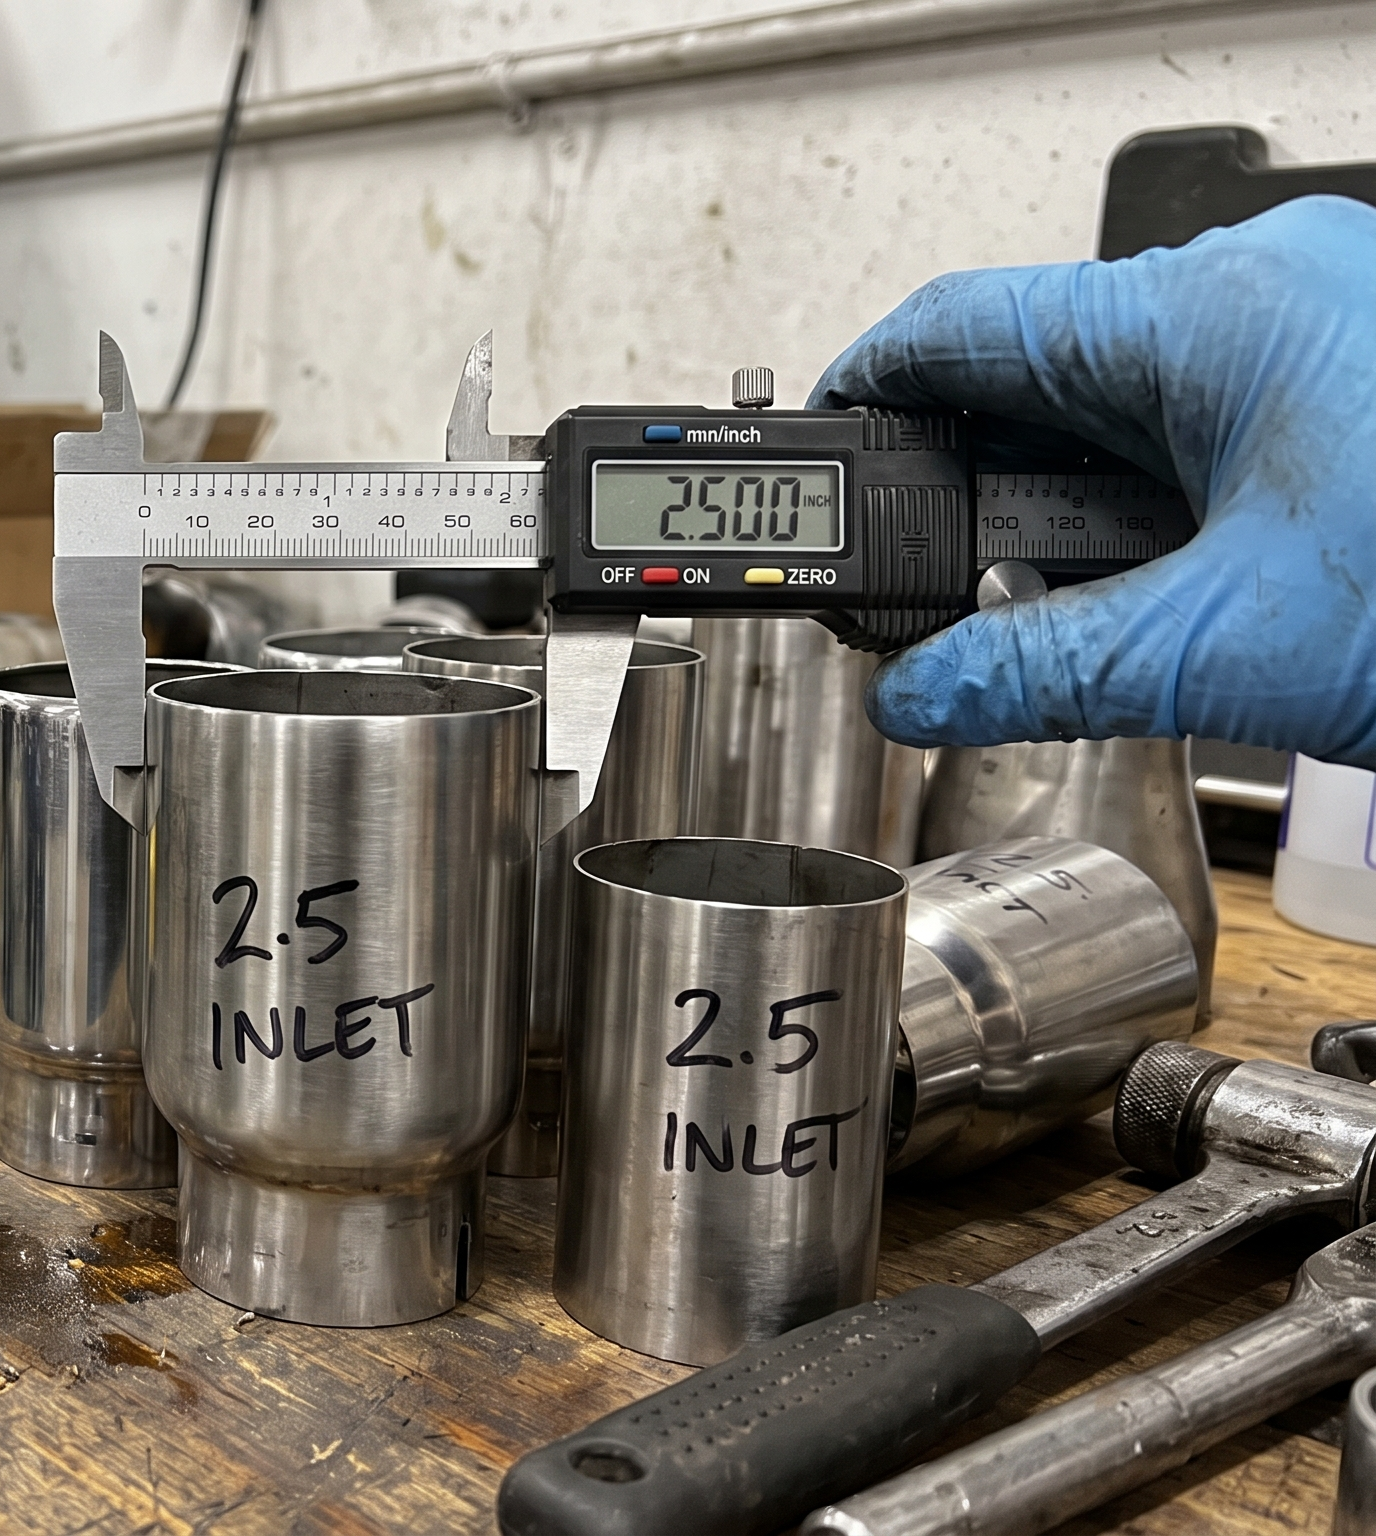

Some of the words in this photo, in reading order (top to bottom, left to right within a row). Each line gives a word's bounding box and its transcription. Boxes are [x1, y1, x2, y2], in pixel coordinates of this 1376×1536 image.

[157, 488, 163, 497] 1
[172, 488, 181, 497] 2
[189, 488, 198, 497] 3
[223, 488, 233, 497] 4
[240, 488, 250, 497] 5
[292, 488, 301, 497] 7
[345, 488, 352, 497] 1
[362, 488, 371, 497] 2
[379, 488, 388, 497] 3
[431, 488, 441, 497] 7
[499, 492, 511, 504] 2
[323, 495, 330, 508] 1
[660, 476, 801, 541] 2.500
[803, 494, 831, 507] INCH
[138, 505, 151, 518] 0
[185, 515, 209, 528] 10
[247, 515, 274, 528] 20
[312, 515, 339, 528] 30
[378, 515, 405, 528] 40
[444, 515, 471, 528] 50
[510, 515, 537, 528] 60
[982, 516, 1019, 530] 100
[1046, 516, 1086, 530] 120
[601, 567, 636, 584] OFF
[683, 567, 710, 584] ON
[787, 568, 837, 585] ZERO
[212, 875, 360, 968] 2.5
[211, 982, 435, 1071] INLET
[665, 988, 846, 1074] 2.5
[663, 1096, 869, 1178] INLET
